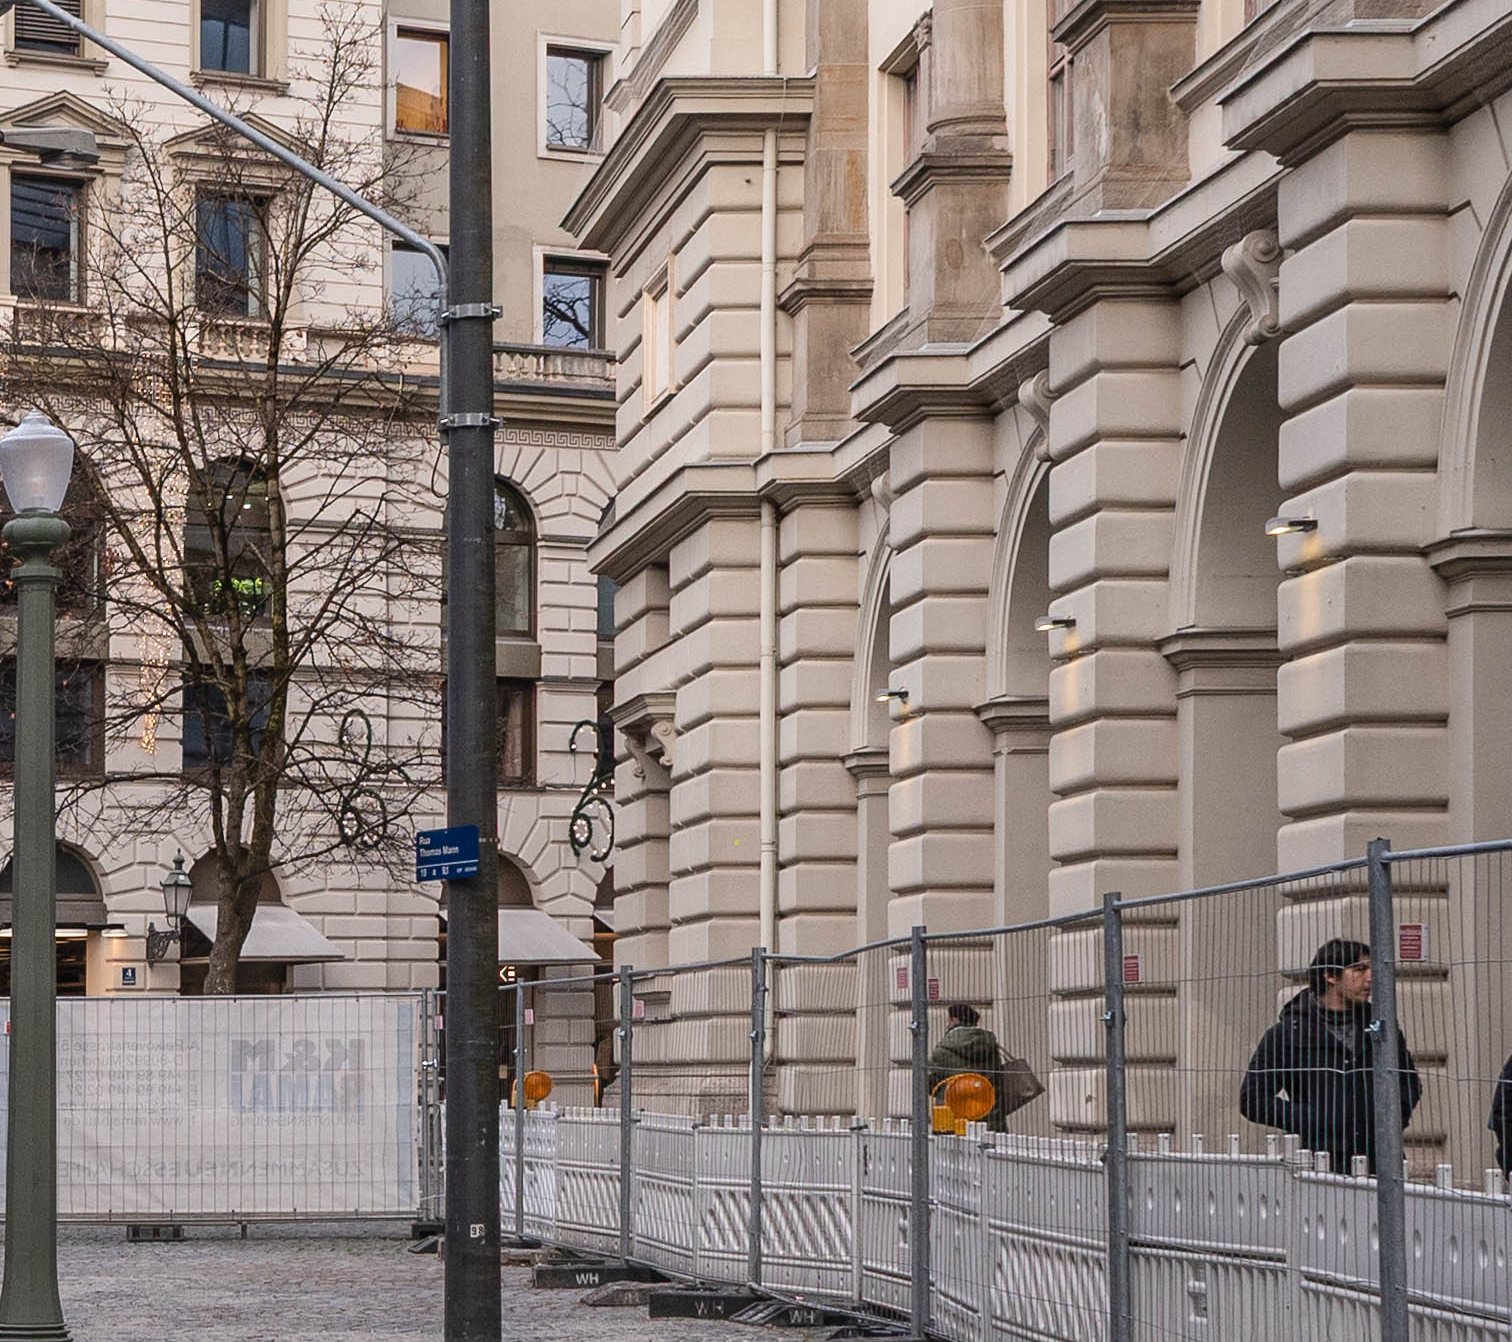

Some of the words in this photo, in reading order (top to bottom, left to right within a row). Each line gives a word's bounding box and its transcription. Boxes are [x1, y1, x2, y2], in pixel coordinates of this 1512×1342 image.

[419, 847, 442, 857] Thomas
[443, 845, 459, 855] Mann
[576, 1272, 599, 1285] WH
[789, 1310, 815, 1324] WH
